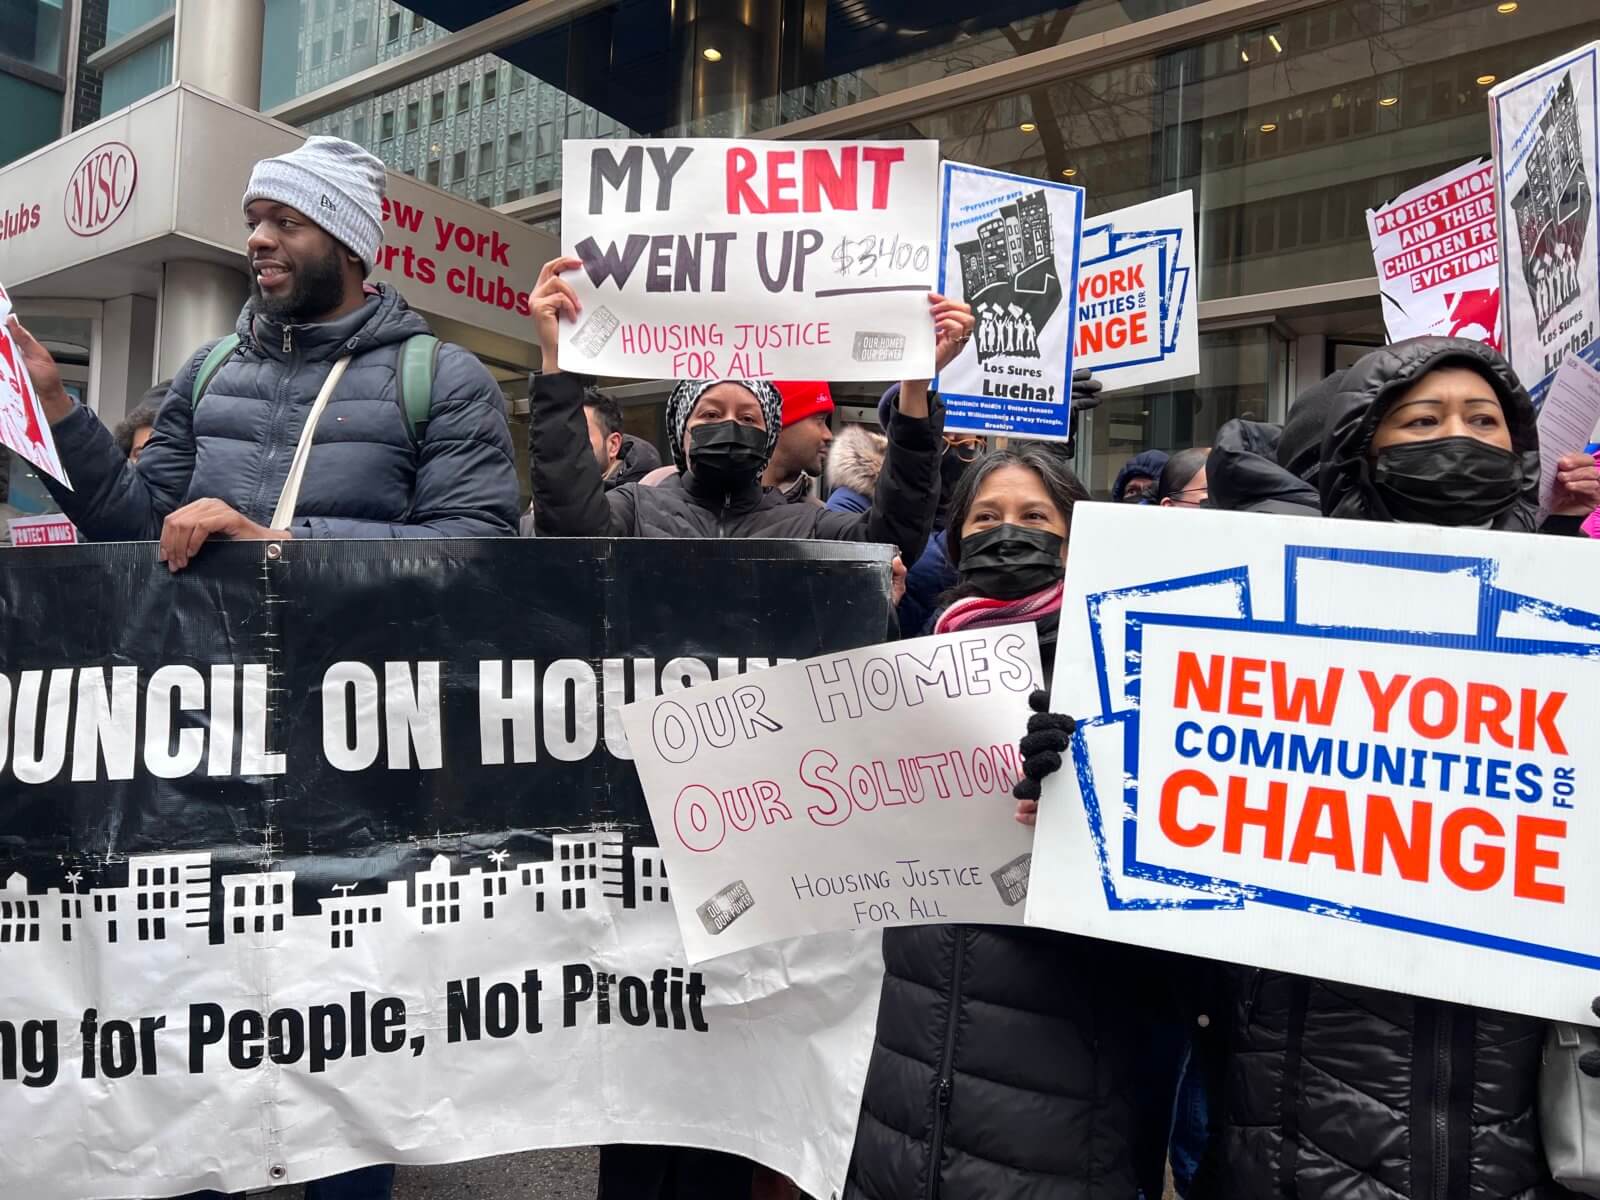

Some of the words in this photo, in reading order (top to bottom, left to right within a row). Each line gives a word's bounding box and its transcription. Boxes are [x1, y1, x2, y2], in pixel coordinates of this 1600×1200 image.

[72, 151, 127, 228] NYSC
[588, 146, 694, 215] MY
[726, 145, 904, 215] RENT
[1376, 188, 1449, 234] PROTECT
[1454, 167, 1494, 200] MOM
[434, 216, 512, 268] york
[1384, 233, 1467, 277] CHILDREN
[1470, 220, 1498, 245] FR
[1402, 221, 1437, 248] AND
[1441, 198, 1493, 231] THEIR
[574, 232, 737, 293] WENT
[756, 229, 824, 293] UP
[1078, 263, 1145, 303] YORK
[1412, 244, 1499, 291] EVICTION!
[446, 265, 532, 317] clubs
[1078, 294, 1136, 322] NITIES
[1137, 290, 1147, 308] FOR
[621, 323, 723, 354] HOUSING
[733, 322, 832, 350] JUSTICE
[1073, 311, 1148, 357] NGE
[1543, 329, 1557, 346] Los
[1559, 310, 1583, 335] Sures
[673, 351, 719, 379] FOR
[727, 351, 774, 377] ALL
[982, 379, 1055, 402] Lucha!
[984, 362, 1004, 374] Los
[1007, 364, 1042, 379] Sures
[0, 663, 287, 784] UNCIL
[322, 660, 443, 772] ON
[652, 685, 783, 764] OUR
[805, 633, 1034, 723] HOMES
[1173, 651, 1345, 727] NEW
[1358, 669, 1569, 756] YORK
[1174, 720, 1544, 804] COMMUNITIES
[1552, 767, 1576, 809] FOR
[673, 779, 792, 852] OUR
[799, 743, 1025, 826] SOLUTION
[1157, 768, 1568, 905] CHANGE
[790, 869, 891, 900] HOUSING
[896, 859, 983, 888] JUSTICE
[854, 902, 899, 924] FOR
[908, 897, 947, 920] ALL
[80, 1007, 166, 1079] for
[189, 990, 425, 1074] People,
[446, 969, 543, 1043] Not
[562, 962, 708, 1032] Profit
